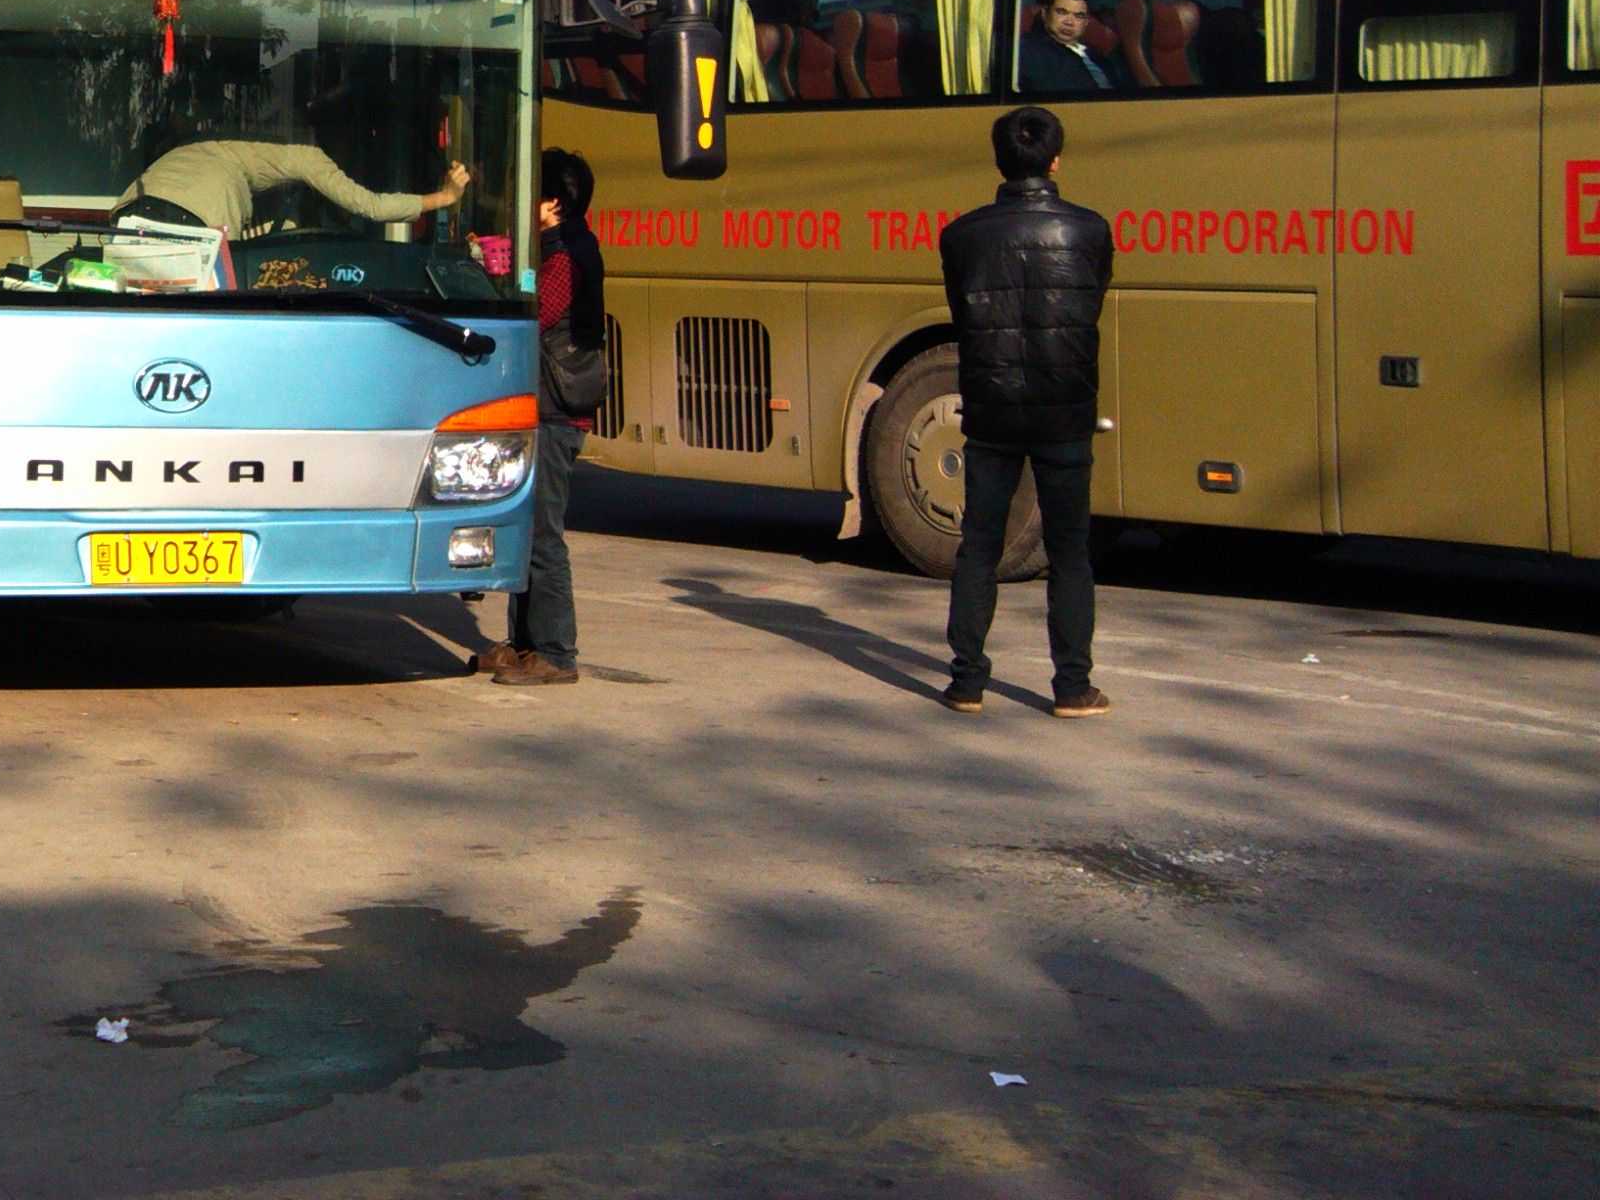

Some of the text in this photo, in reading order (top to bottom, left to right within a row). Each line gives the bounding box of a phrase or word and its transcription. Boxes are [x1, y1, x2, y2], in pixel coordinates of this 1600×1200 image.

[721, 209, 842, 250] MOTOR
[1113, 208, 1415, 256] CORPORATION
[26, 459, 305, 484] ANKAI
[143, 540, 238, 575] Y0367
